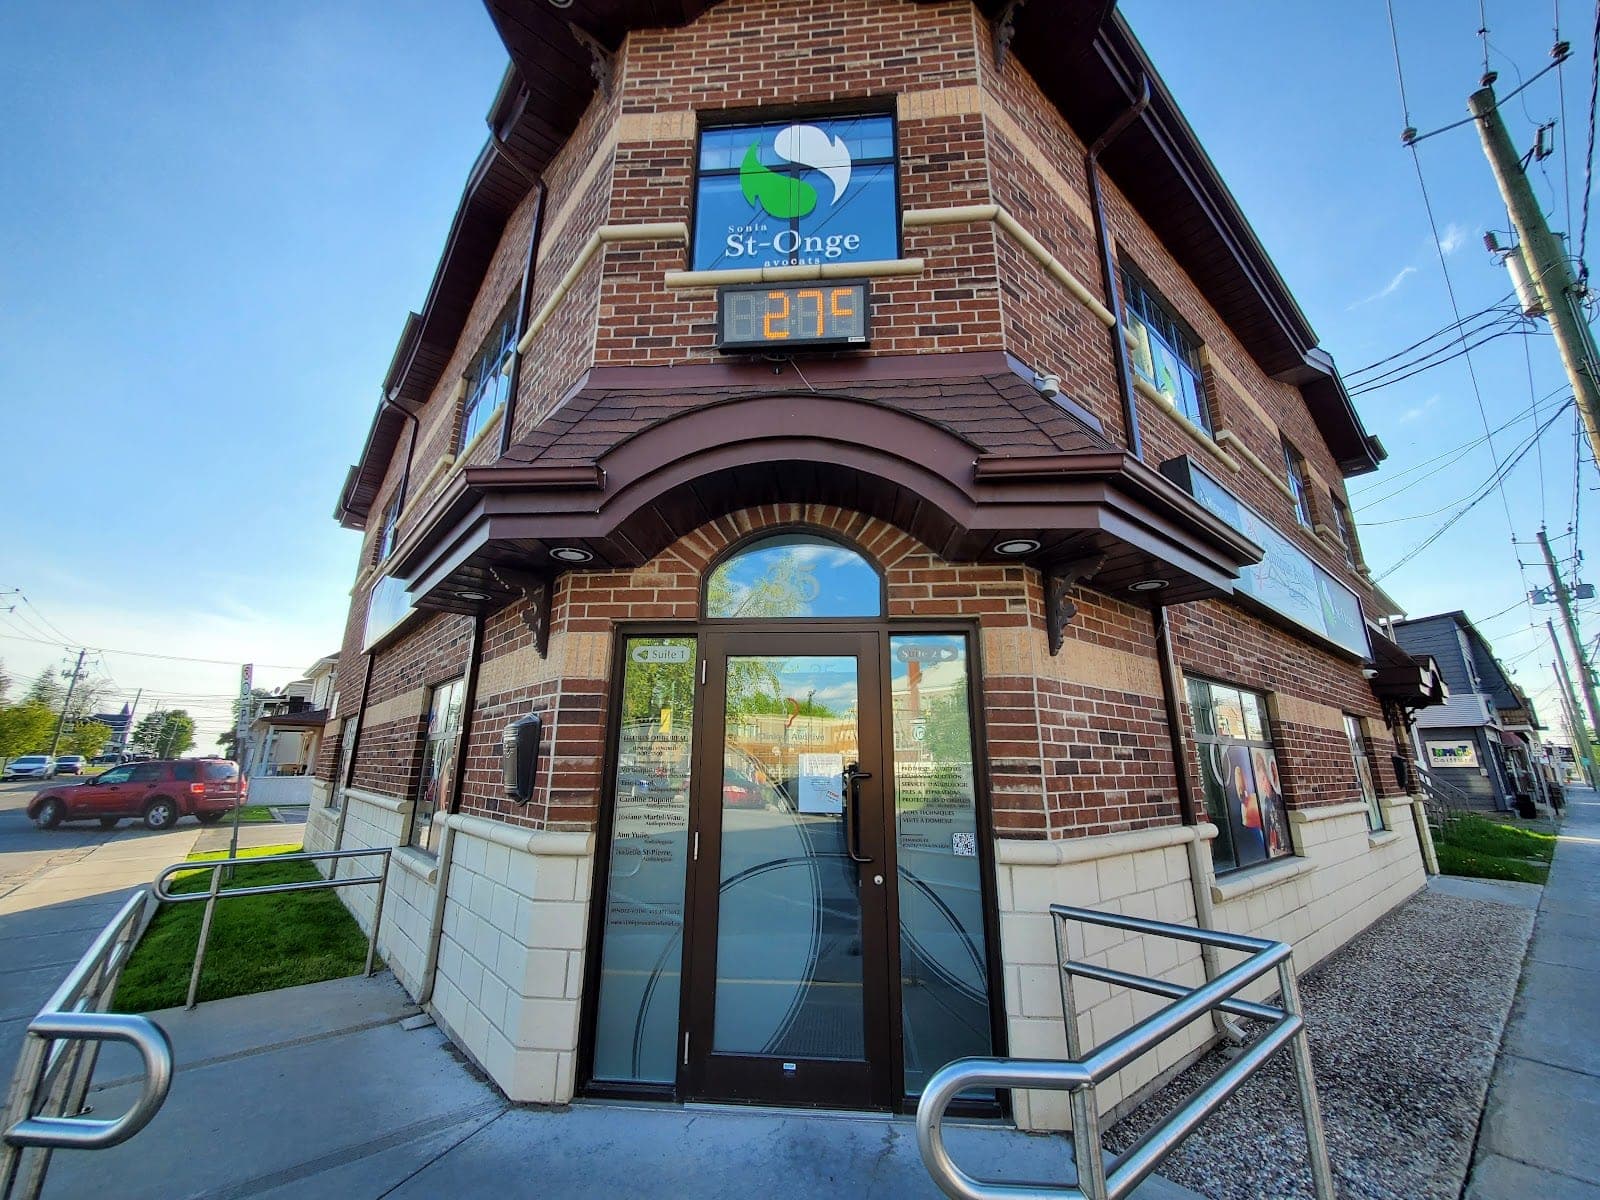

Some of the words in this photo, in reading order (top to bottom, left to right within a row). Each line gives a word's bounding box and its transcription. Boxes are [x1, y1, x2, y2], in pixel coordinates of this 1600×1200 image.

[728, 223, 768, 233] Sonia
[725, 229, 860, 258] St-Onge
[764, 257, 820, 267] avocats
[652, 649, 677, 659] Suite
